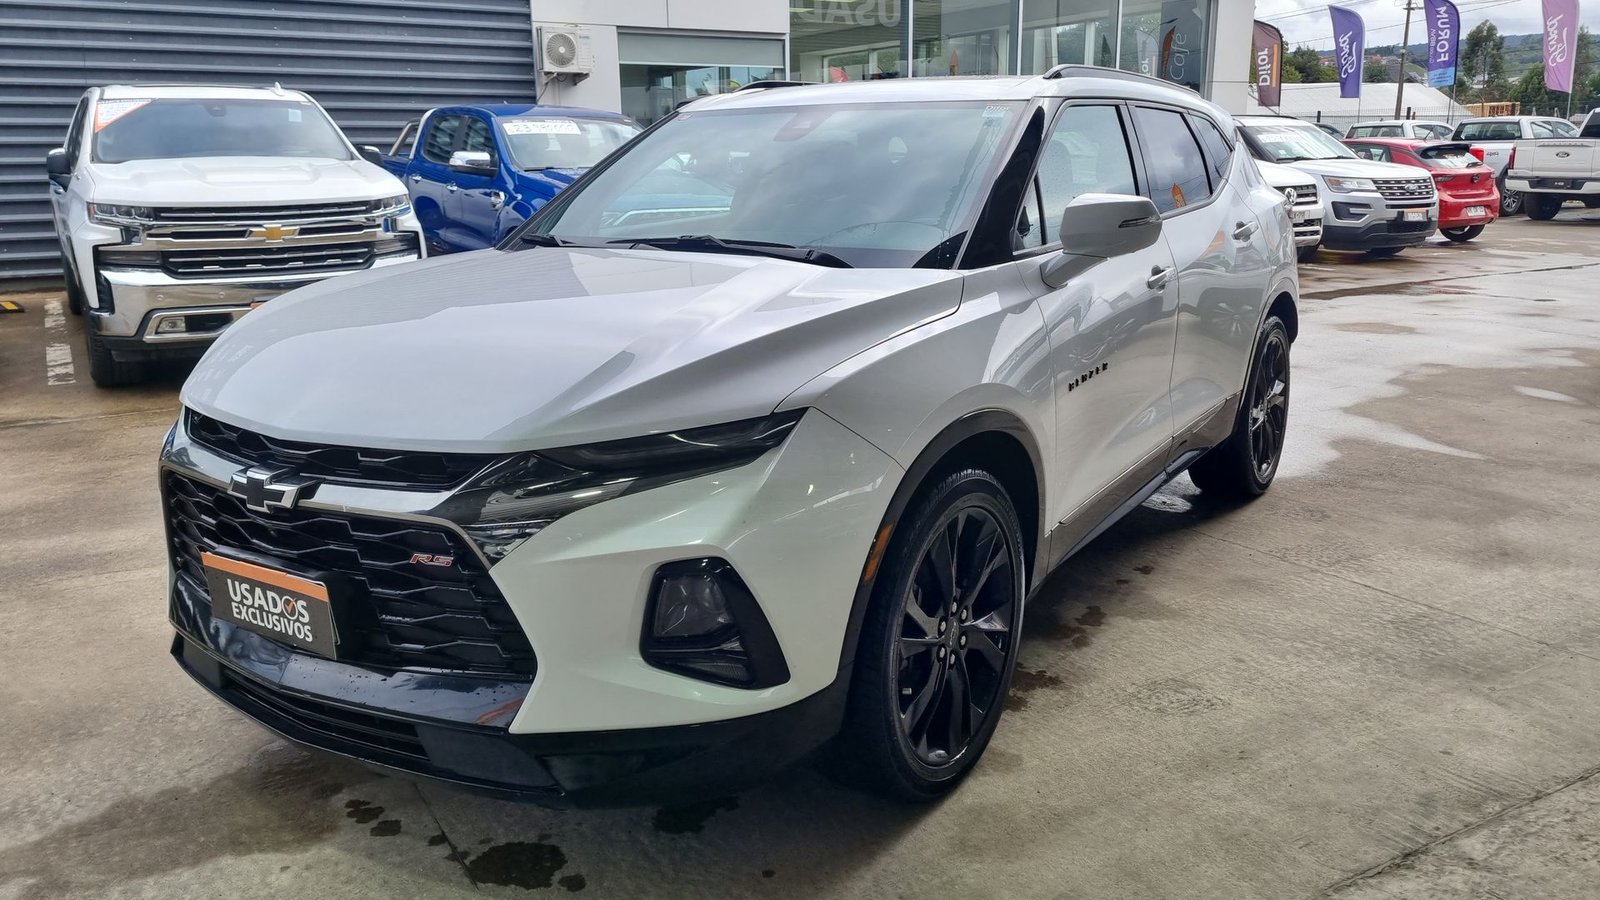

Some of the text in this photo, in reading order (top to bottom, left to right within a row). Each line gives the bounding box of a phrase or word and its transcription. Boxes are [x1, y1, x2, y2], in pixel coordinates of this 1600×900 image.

[410, 554, 454, 567] RS
[227, 579, 309, 623] USADOS
[232, 602, 313, 642] EXCLUSIVOS
